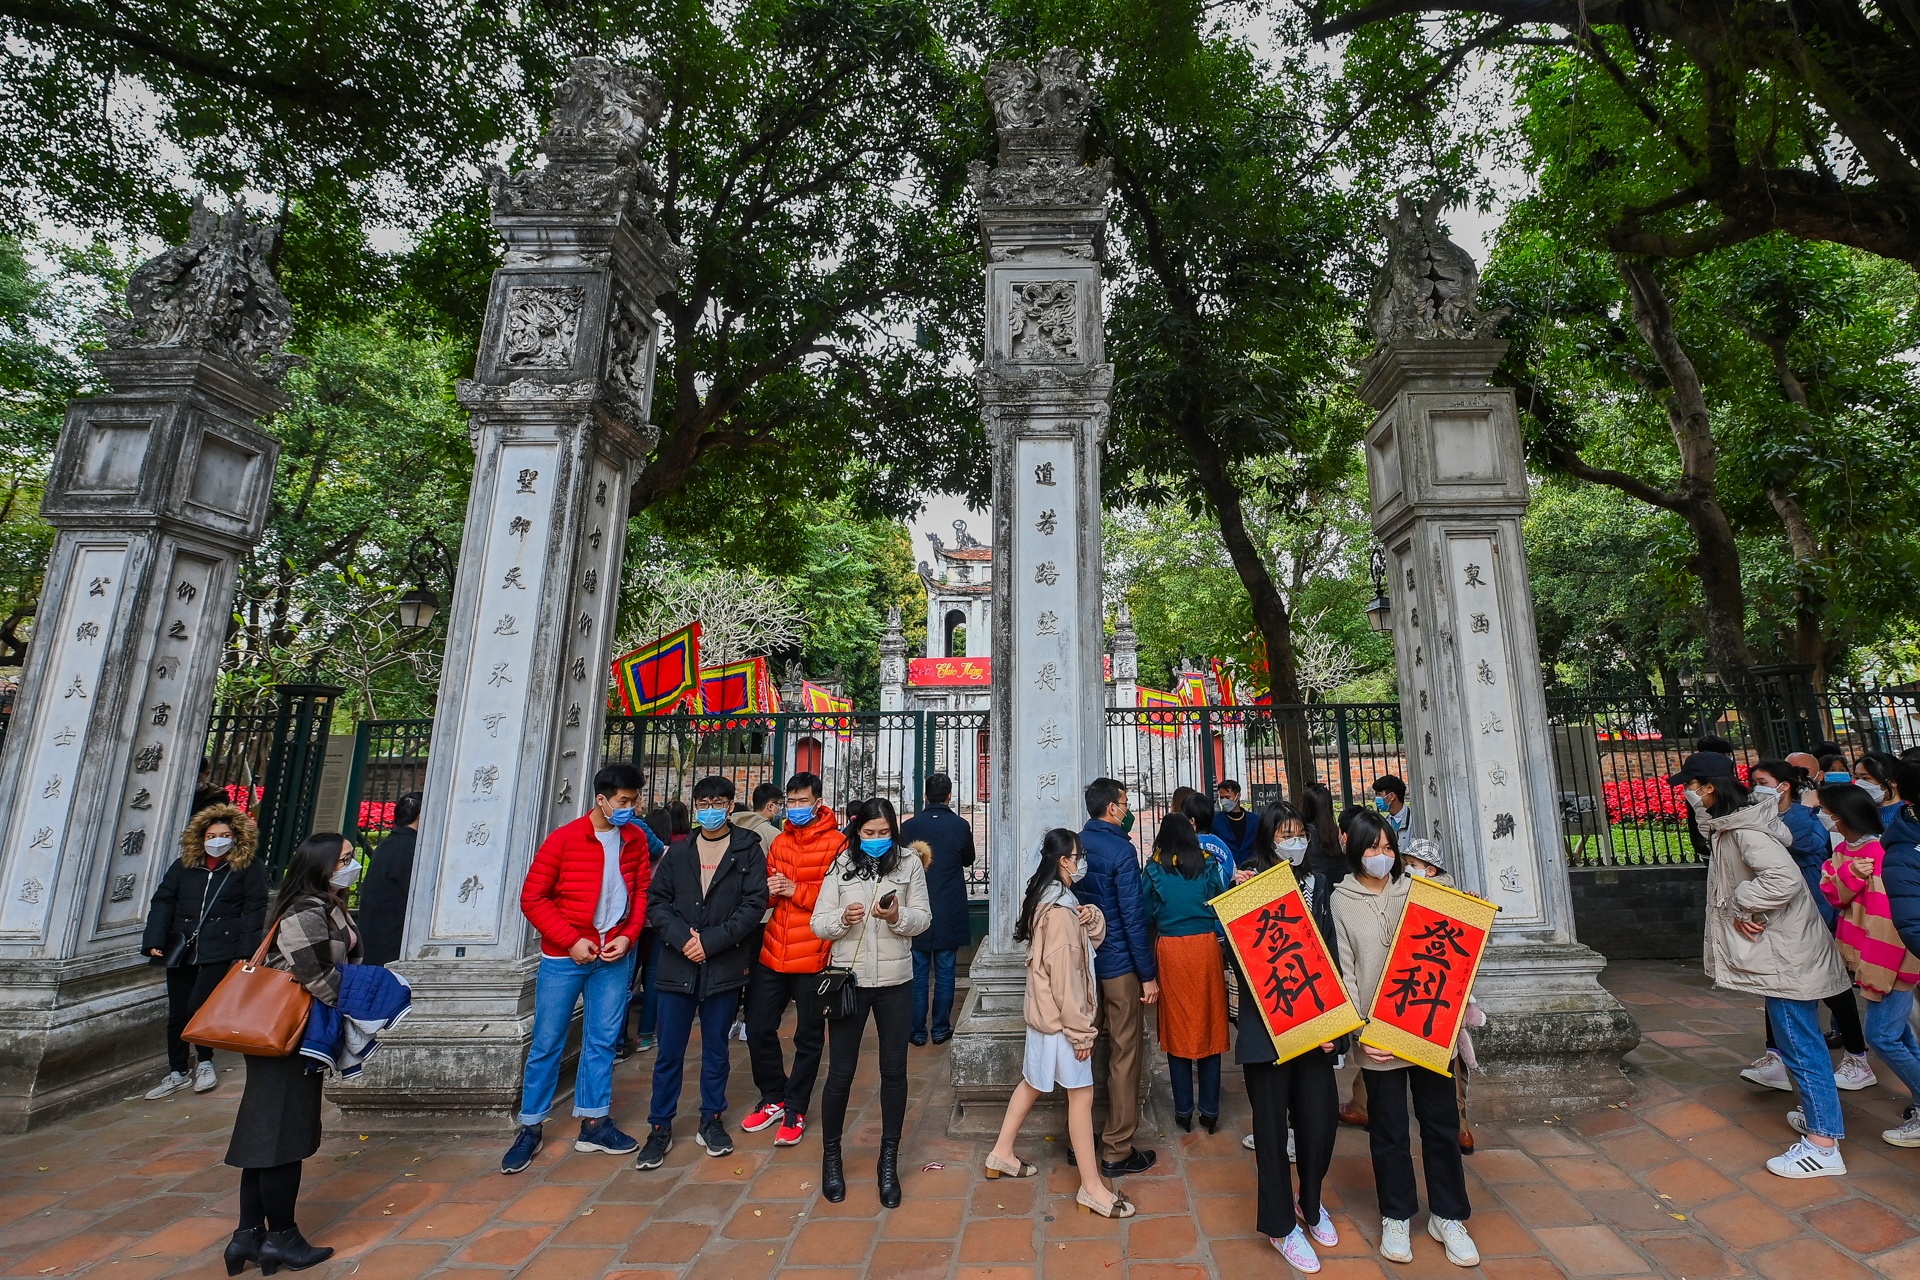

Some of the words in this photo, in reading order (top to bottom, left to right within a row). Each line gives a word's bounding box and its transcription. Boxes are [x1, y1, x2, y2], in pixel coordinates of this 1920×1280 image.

[1205, 842, 1228, 862] SEVEN
[1252, 904, 1324, 1018] 登科
[1385, 920, 1471, 1037] 登科
